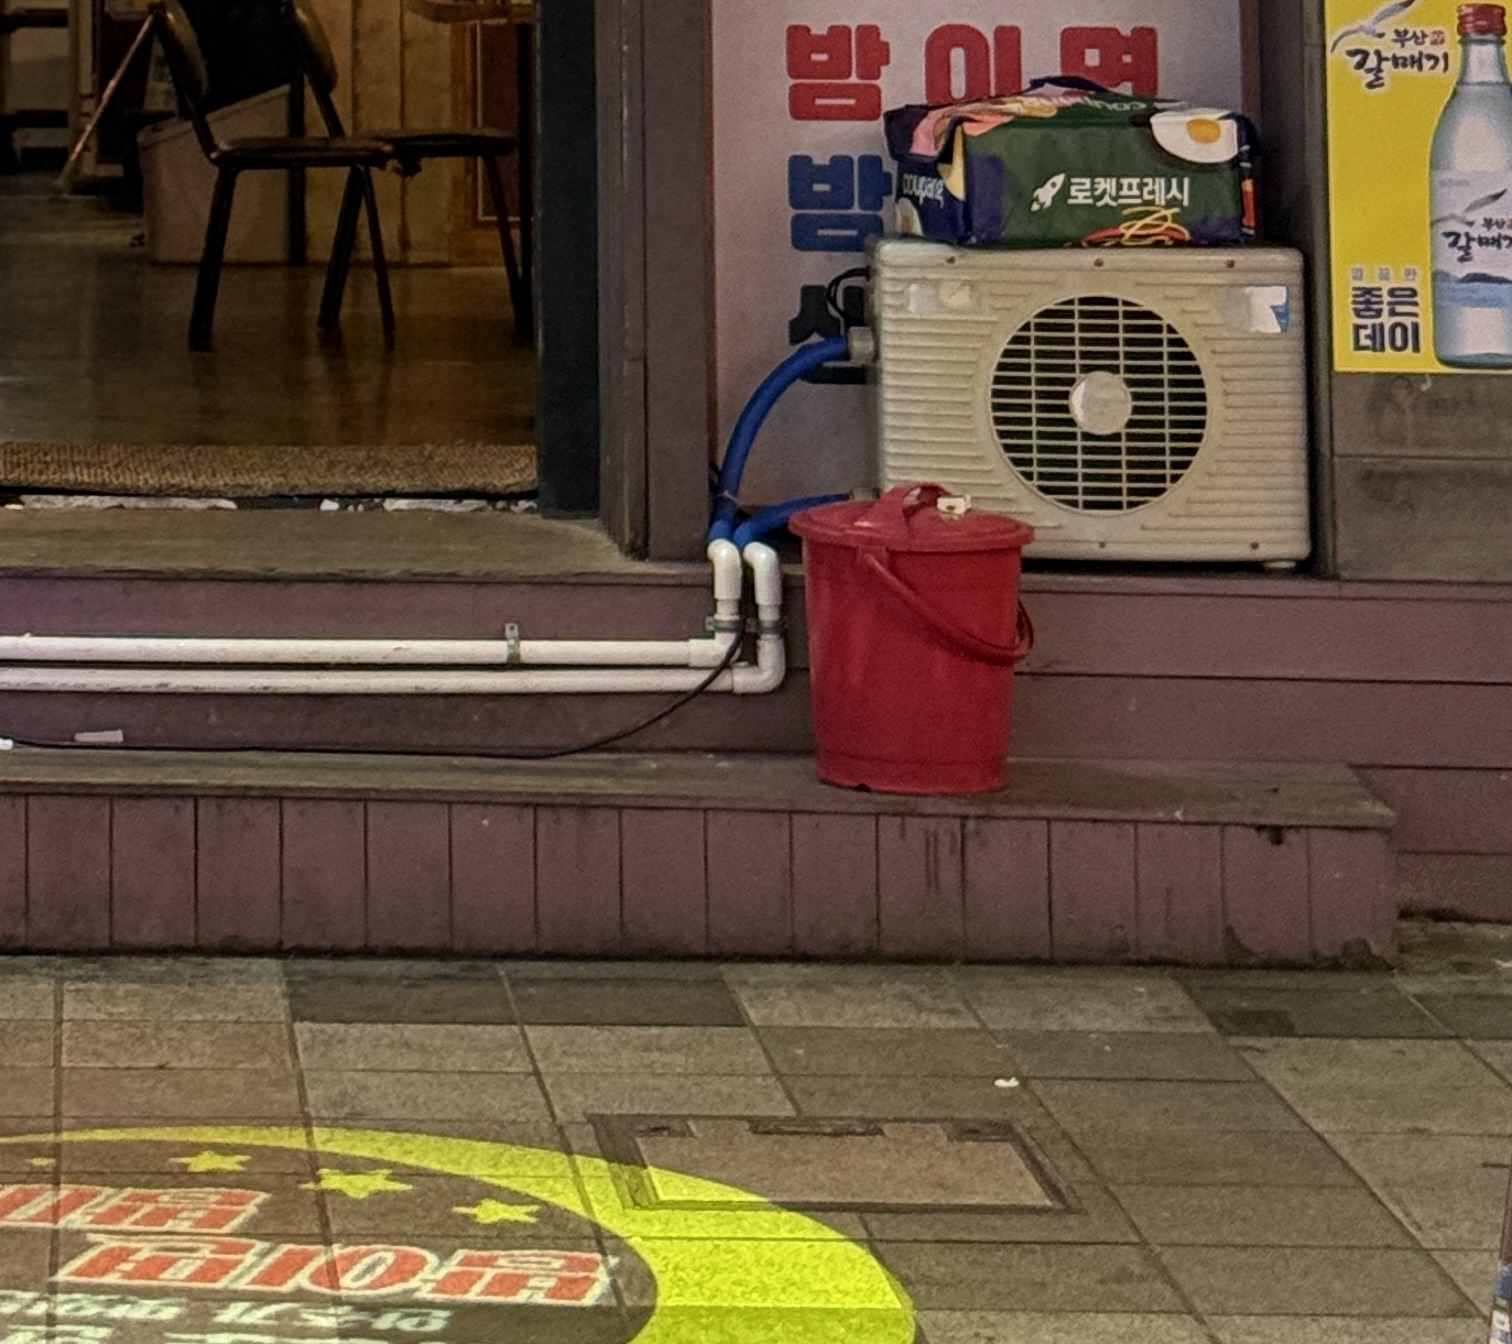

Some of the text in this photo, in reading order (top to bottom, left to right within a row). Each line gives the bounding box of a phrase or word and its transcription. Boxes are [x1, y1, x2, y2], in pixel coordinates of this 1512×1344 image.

[1392, 27, 1428, 48] 부산
[1345, 49, 1450, 89] 갈매기
[1067, 175, 1189, 208] 로켓프레시
[1351, 286, 1420, 320] 좋은
[1352, 321, 1421, 354] 데이
